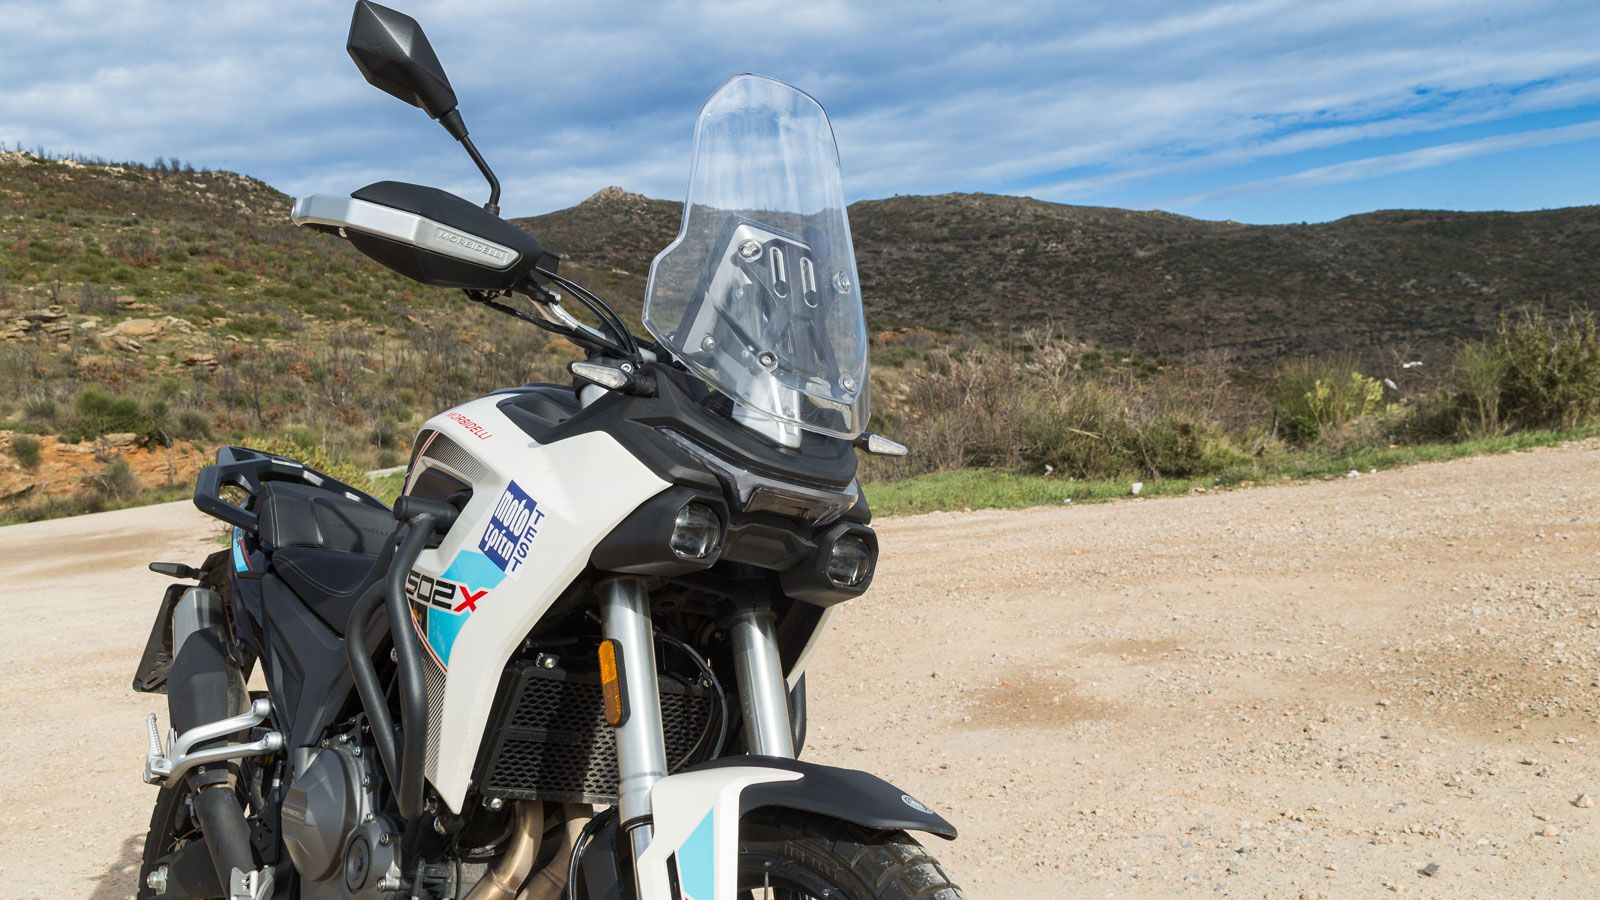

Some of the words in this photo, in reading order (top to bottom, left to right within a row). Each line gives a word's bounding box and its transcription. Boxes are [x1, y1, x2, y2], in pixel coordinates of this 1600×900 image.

[439, 230, 503, 260] MORBIDELLI
[494, 489, 530, 537] moto
[511, 508, 545, 573] TEST
[406, 569, 489, 612] 502X
